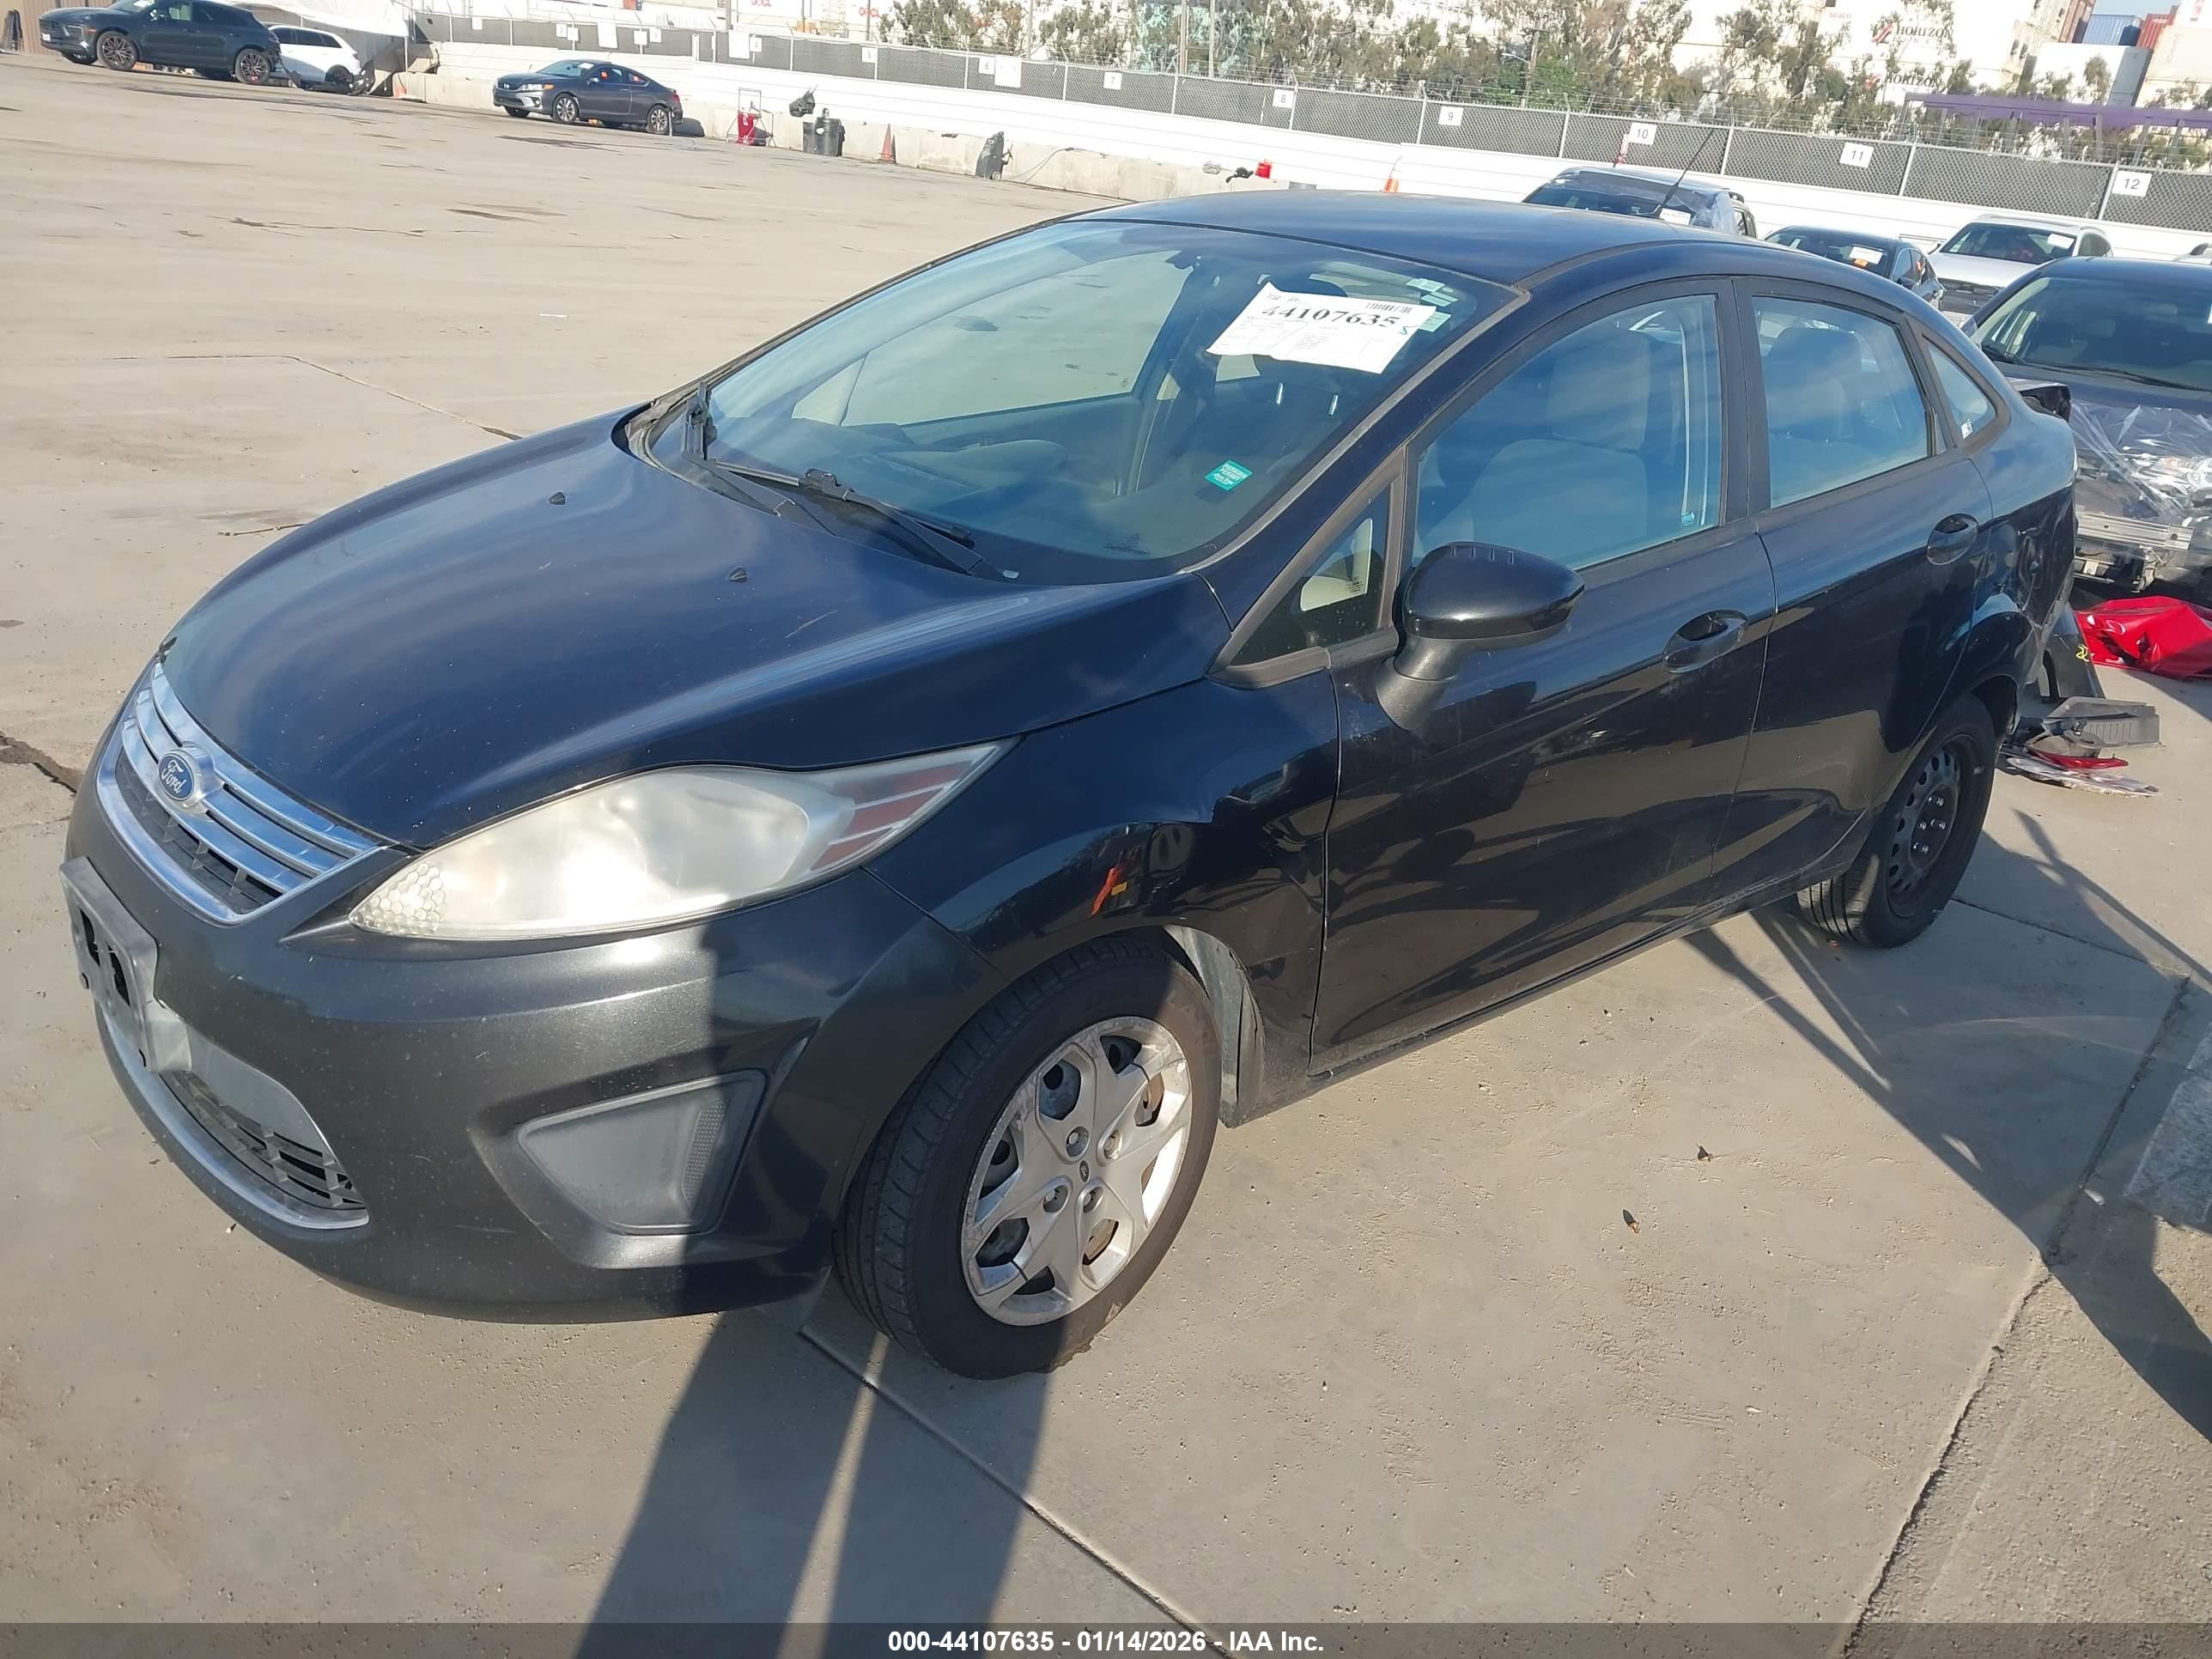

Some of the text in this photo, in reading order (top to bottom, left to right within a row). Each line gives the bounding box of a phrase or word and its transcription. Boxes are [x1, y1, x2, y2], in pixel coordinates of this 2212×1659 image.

[1897, 26, 1953, 39] HORIZON
[1280, 94, 1286, 103] 8
[1448, 112, 1454, 121] 9
[1637, 129, 1649, 139] 10
[1851, 149, 1864, 161] 11
[2124, 178, 2141, 190] 12
[1261, 306, 1401, 328] 44107635
[161, 759, 187, 793] Ford
